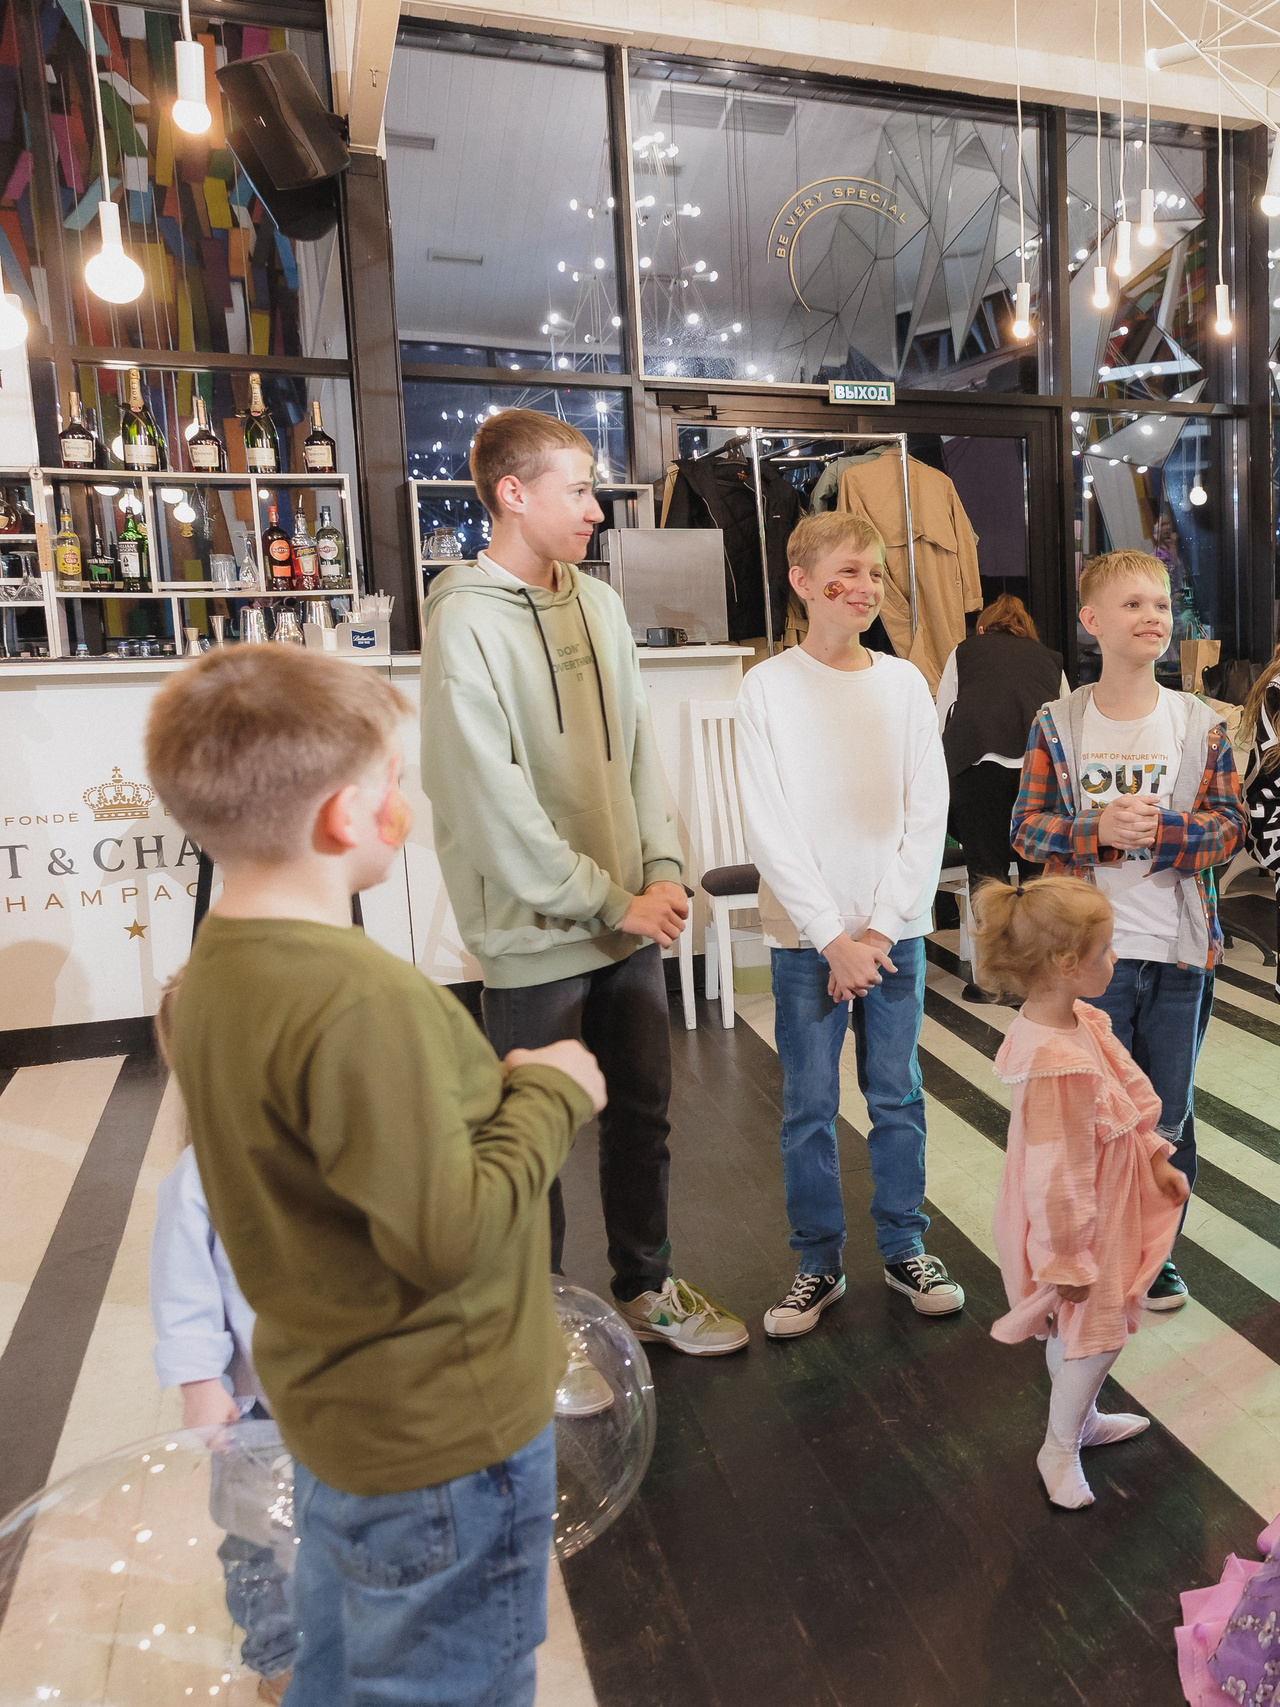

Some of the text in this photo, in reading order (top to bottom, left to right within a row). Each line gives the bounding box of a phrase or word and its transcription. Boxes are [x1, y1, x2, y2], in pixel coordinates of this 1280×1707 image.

[776, 187, 906, 259] BE VERY SPECIAL
[835, 385, 889, 401] ВЫХОД
[1082, 752, 1089, 761] BE
[1091, 752, 1108, 760] PART
[1080, 762, 1167, 795] OUT
[4, 811, 80, 827] FONDÉ
[47, 847, 79, 876] &
